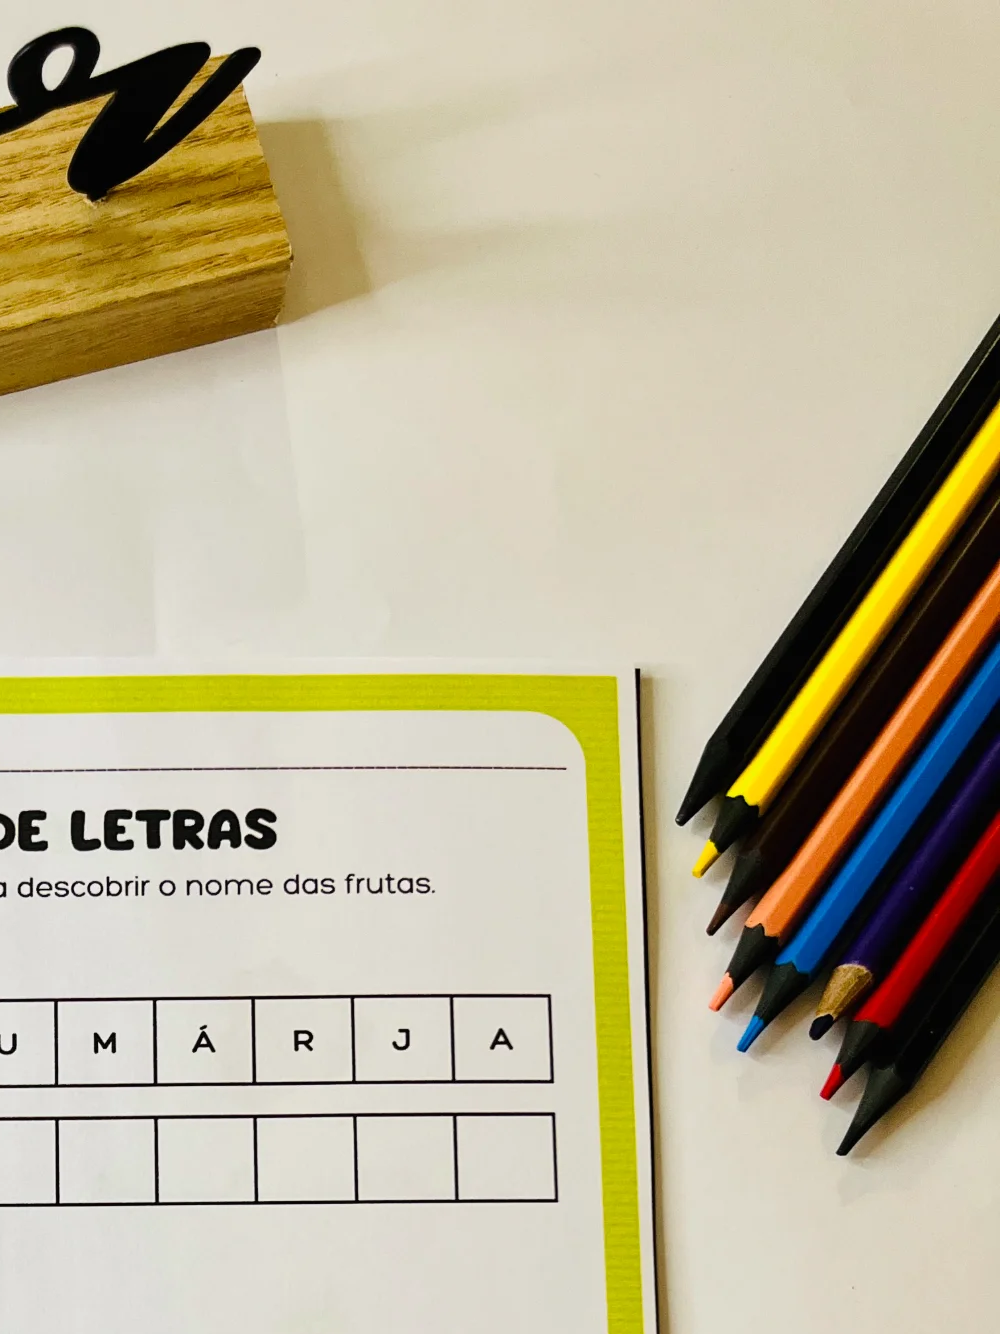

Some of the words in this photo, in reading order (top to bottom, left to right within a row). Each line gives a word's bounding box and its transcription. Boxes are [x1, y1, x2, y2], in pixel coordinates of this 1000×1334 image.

[70, 807, 278, 852] LETRAS
[16, 875, 151, 899] descobrir
[158, 879, 177, 897] o
[185, 878, 274, 897] nome
[283, 873, 336, 896] das
[343, 872, 437, 895] frutas.
[93, 1031, 117, 1055] M
[191, 1024, 217, 1054] Á
[293, 1029, 315, 1053] R
[391, 1028, 411, 1052] J
[489, 1027, 514, 1051] A
